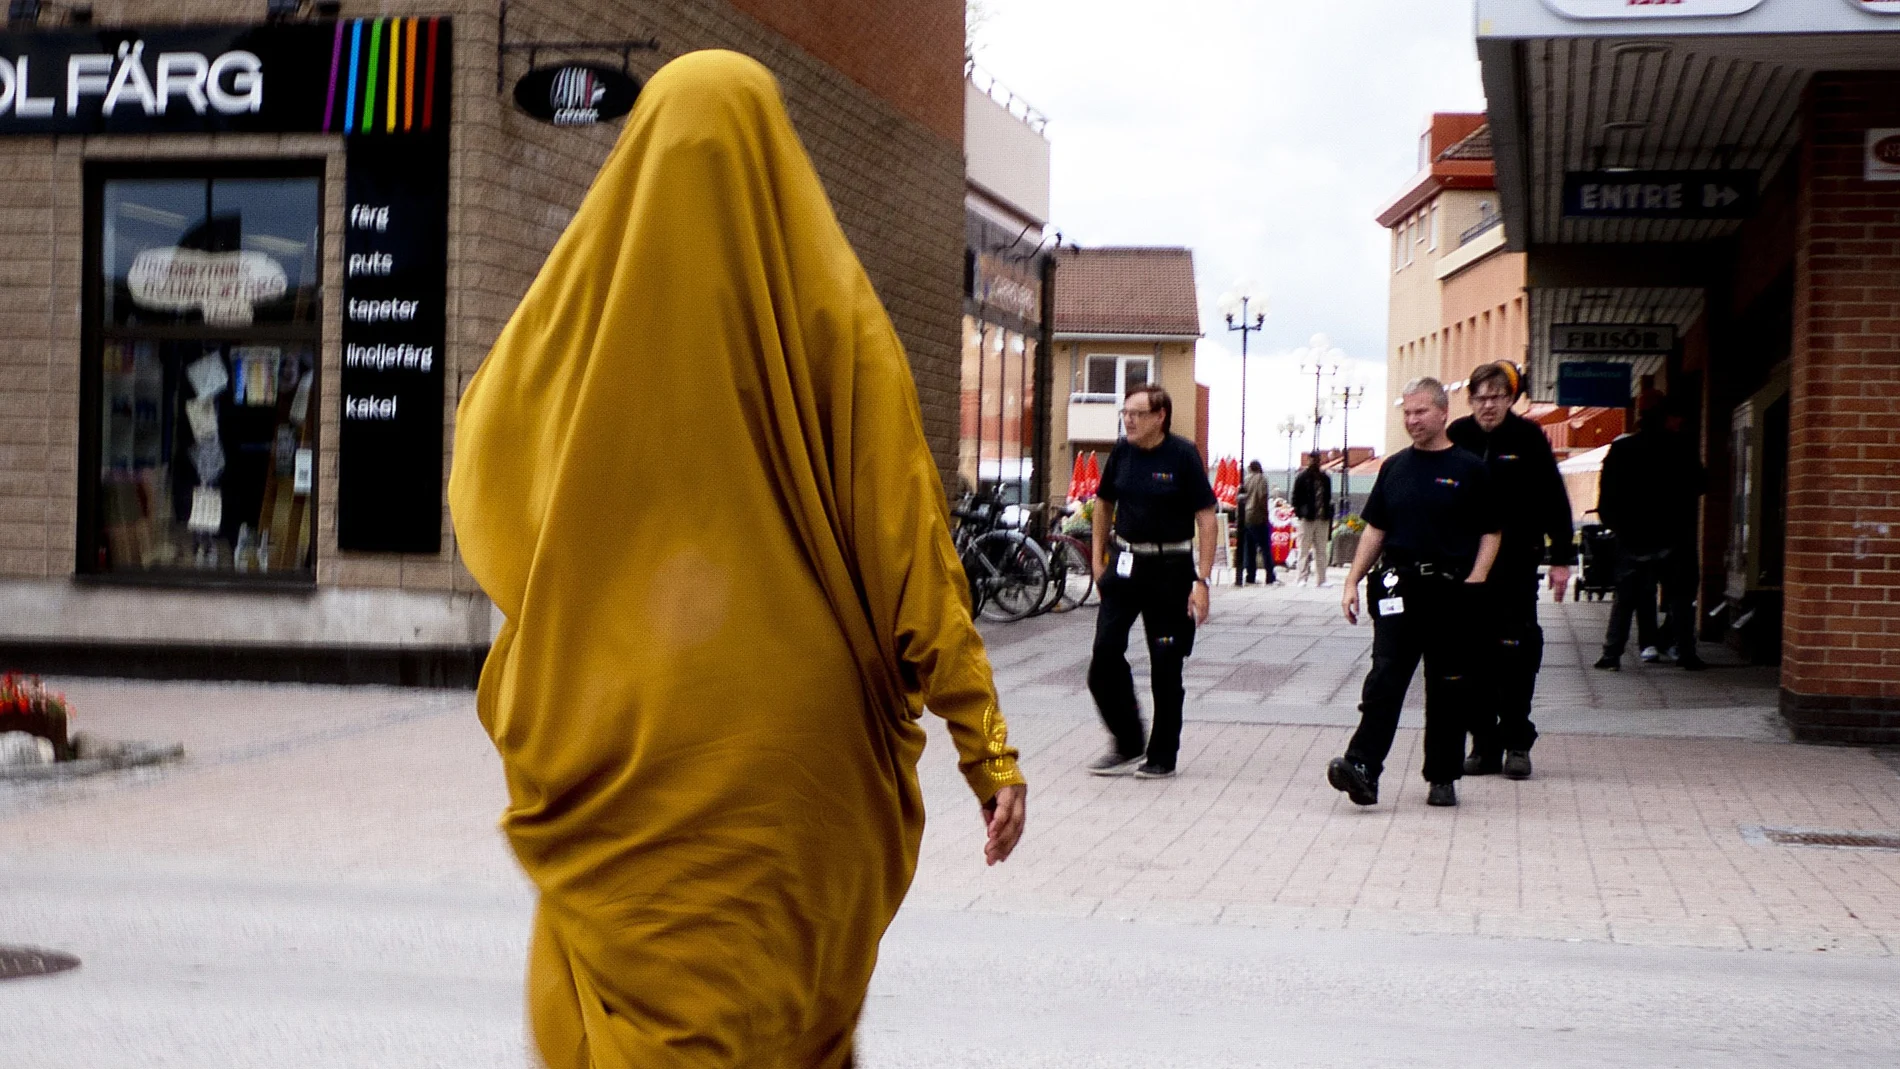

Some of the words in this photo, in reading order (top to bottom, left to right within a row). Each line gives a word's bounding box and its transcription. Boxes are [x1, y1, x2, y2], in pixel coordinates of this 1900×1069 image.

[0, 54, 55, 117] L
[67, 40, 263, 116] FÄRG
[1580, 183, 1682, 209] ENTRE
[351, 204, 389, 232] färg
[350, 250, 392, 277] puts
[349, 297, 418, 324] tapeter
[1566, 328, 1659, 348] FRISÖR
[347, 343, 432, 372] linoljefärg
[346, 394, 396, 419] kakel
